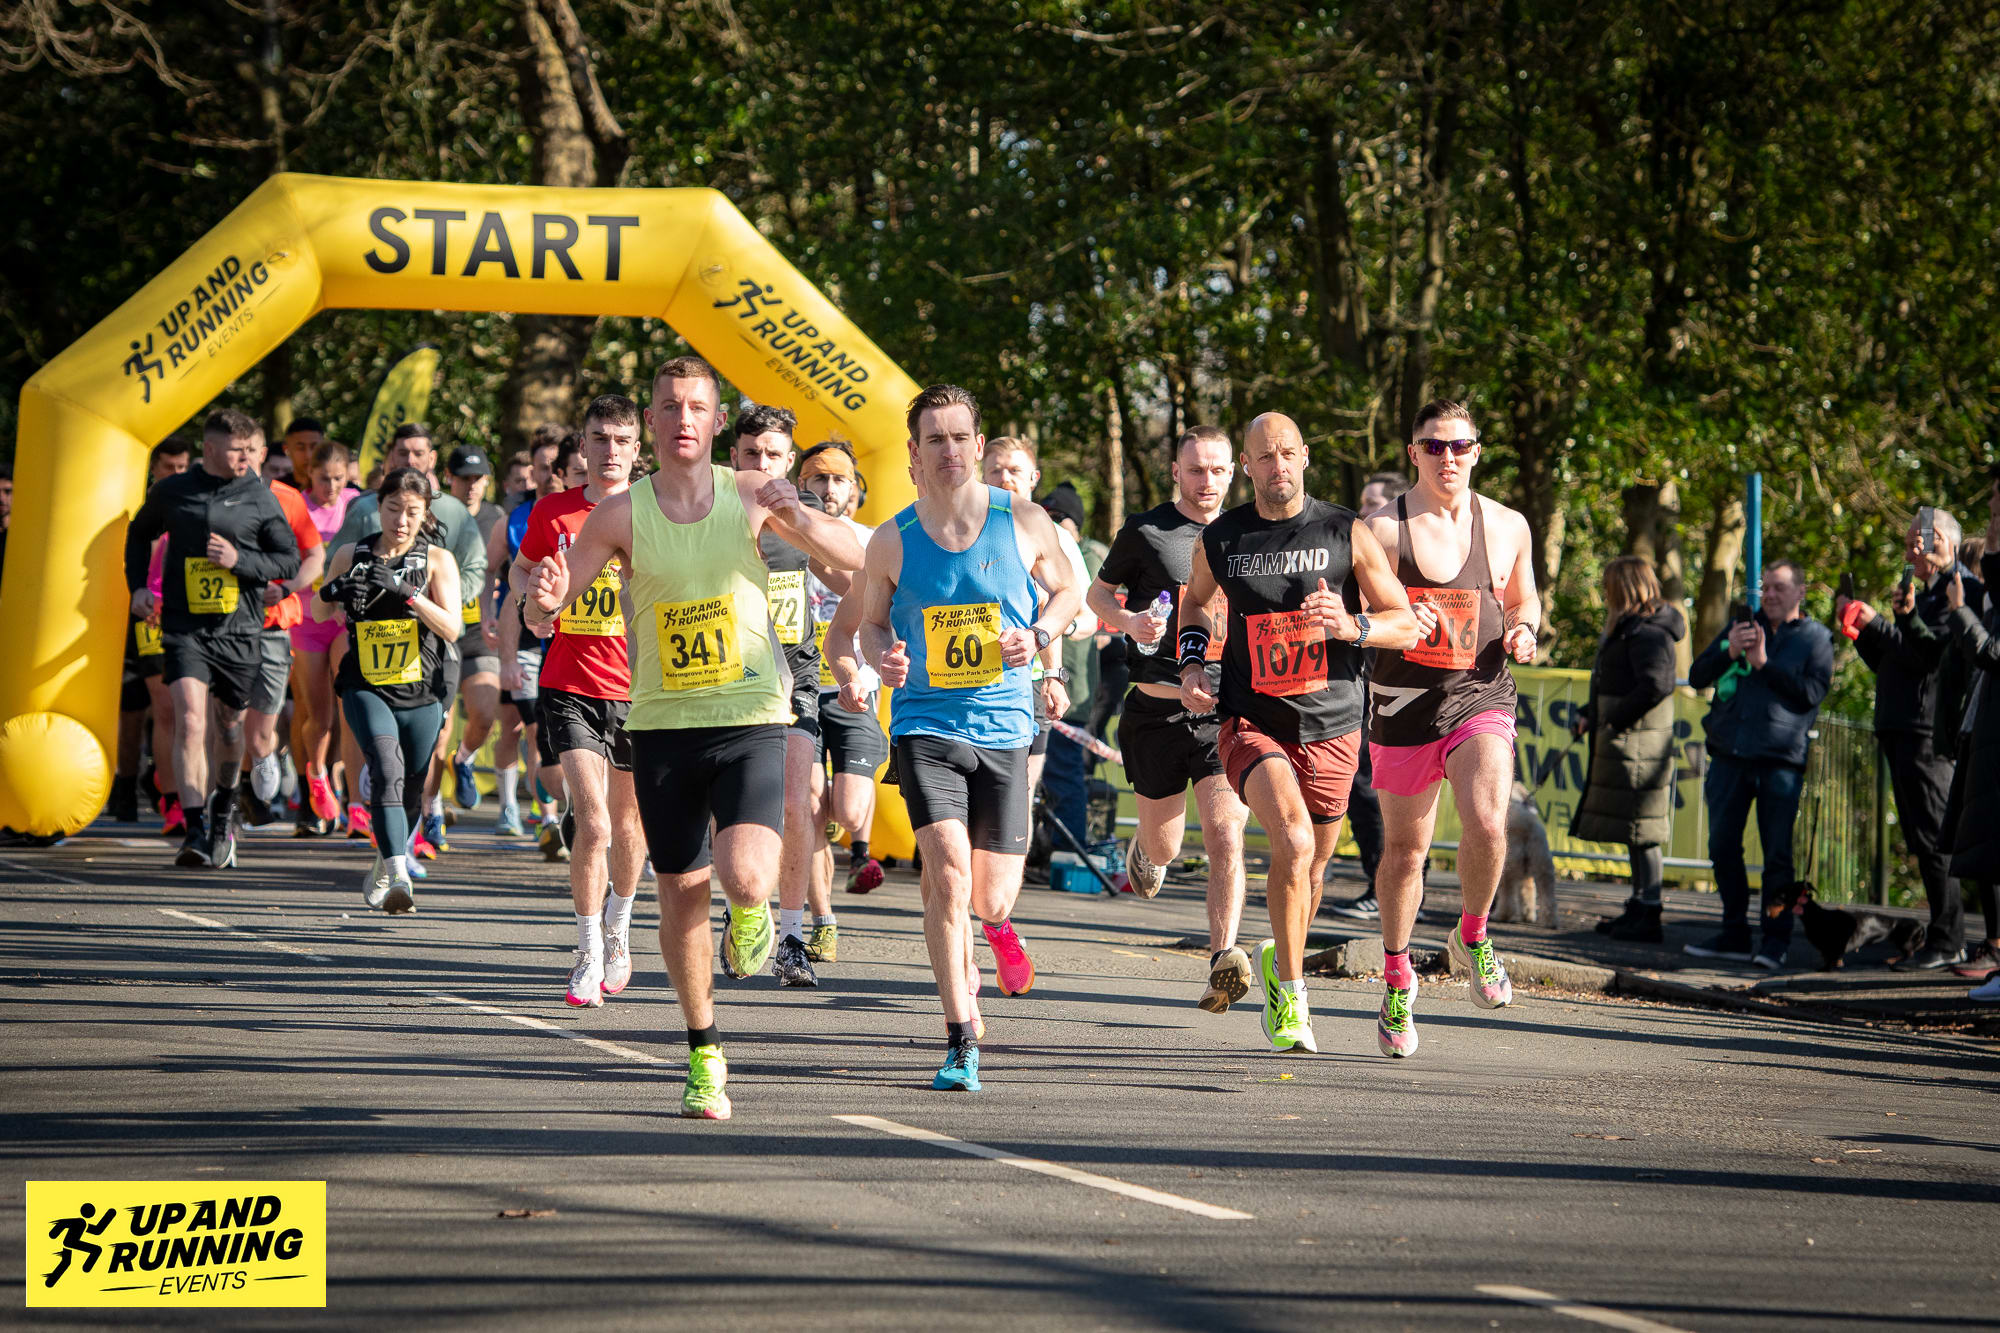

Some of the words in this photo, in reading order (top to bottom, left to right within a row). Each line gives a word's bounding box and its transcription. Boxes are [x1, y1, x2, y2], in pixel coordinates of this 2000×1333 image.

[364, 206, 640, 281] START
[158, 300, 190, 337] UP
[192, 255, 241, 311] AND
[165, 261, 269, 368] RUNNING
[207, 307, 254, 358] EVENTS
[782, 309, 818, 339] UP
[813, 340, 869, 383] AND
[752, 318, 866, 412] RUNNING
[765, 357, 819, 401] EVENTS
[1227, 548, 1330, 577] TEAMXND
[199, 577, 224, 600] 32
[780, 574, 796, 582] AND
[682, 606, 697, 617] UP
[698, 600, 721, 612] AND
[1433, 593, 1447, 601] UP
[1447, 593, 1469, 601] AND
[1433, 601, 1473, 609] UNNING
[678, 607, 728, 626] RUNNING
[946, 614, 992, 628] RUNNING
[950, 609, 963, 619] UP
[963, 607, 987, 617] AND
[1274, 616, 1287, 626] UP
[1271, 622, 1310, 636] RUNNIN
[371, 641, 410, 669] 177
[670, 628, 726, 669] 341
[945, 634, 983, 669] 60
[1180, 639, 1207, 656] ELI
[1256, 640, 1325, 678] 1079
[665, 670, 703, 678] Kelvingrove
